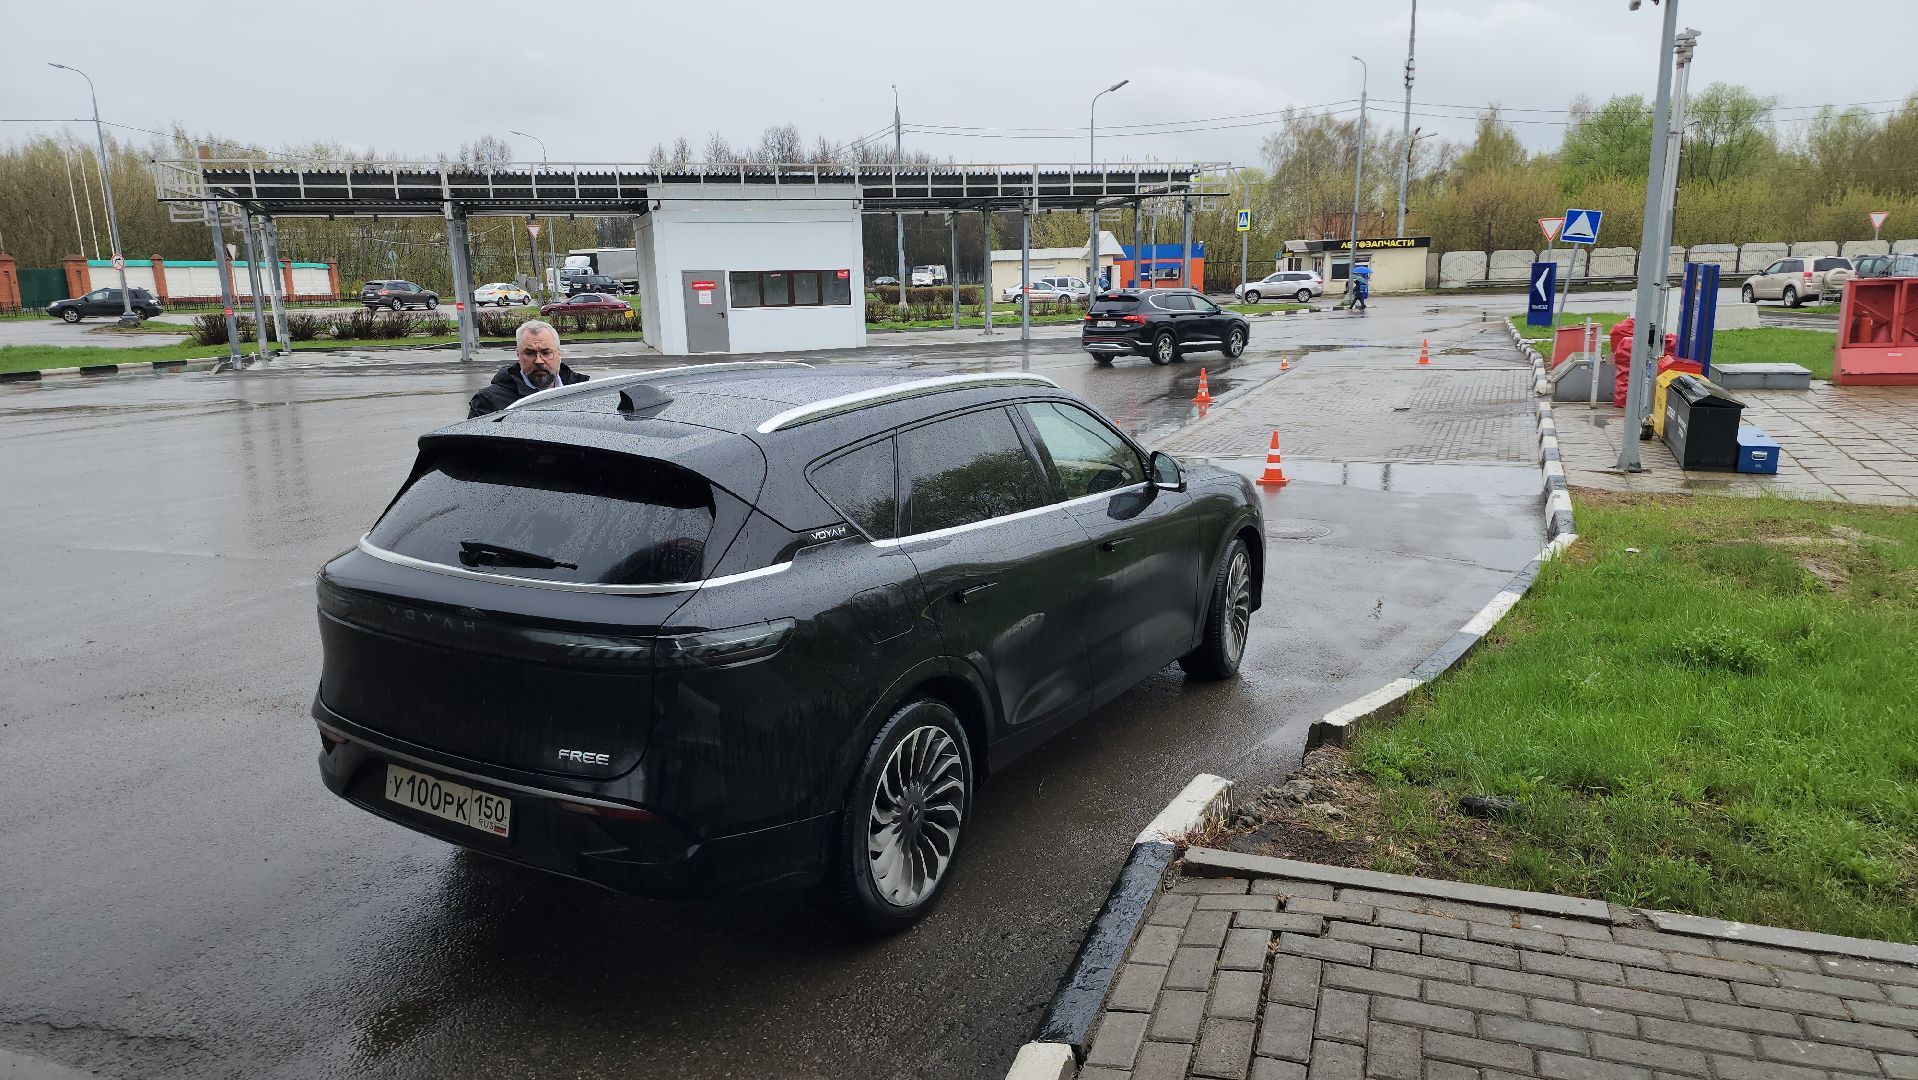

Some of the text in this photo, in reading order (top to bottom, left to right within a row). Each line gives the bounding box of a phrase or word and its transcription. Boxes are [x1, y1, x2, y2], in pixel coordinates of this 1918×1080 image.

[811, 527, 846, 540] VOYAH
[388, 606, 476, 633] VOYAH
[559, 749, 610, 766] FREE
[475, 794, 505, 823] 150
[479, 819, 494, 830] RUS
